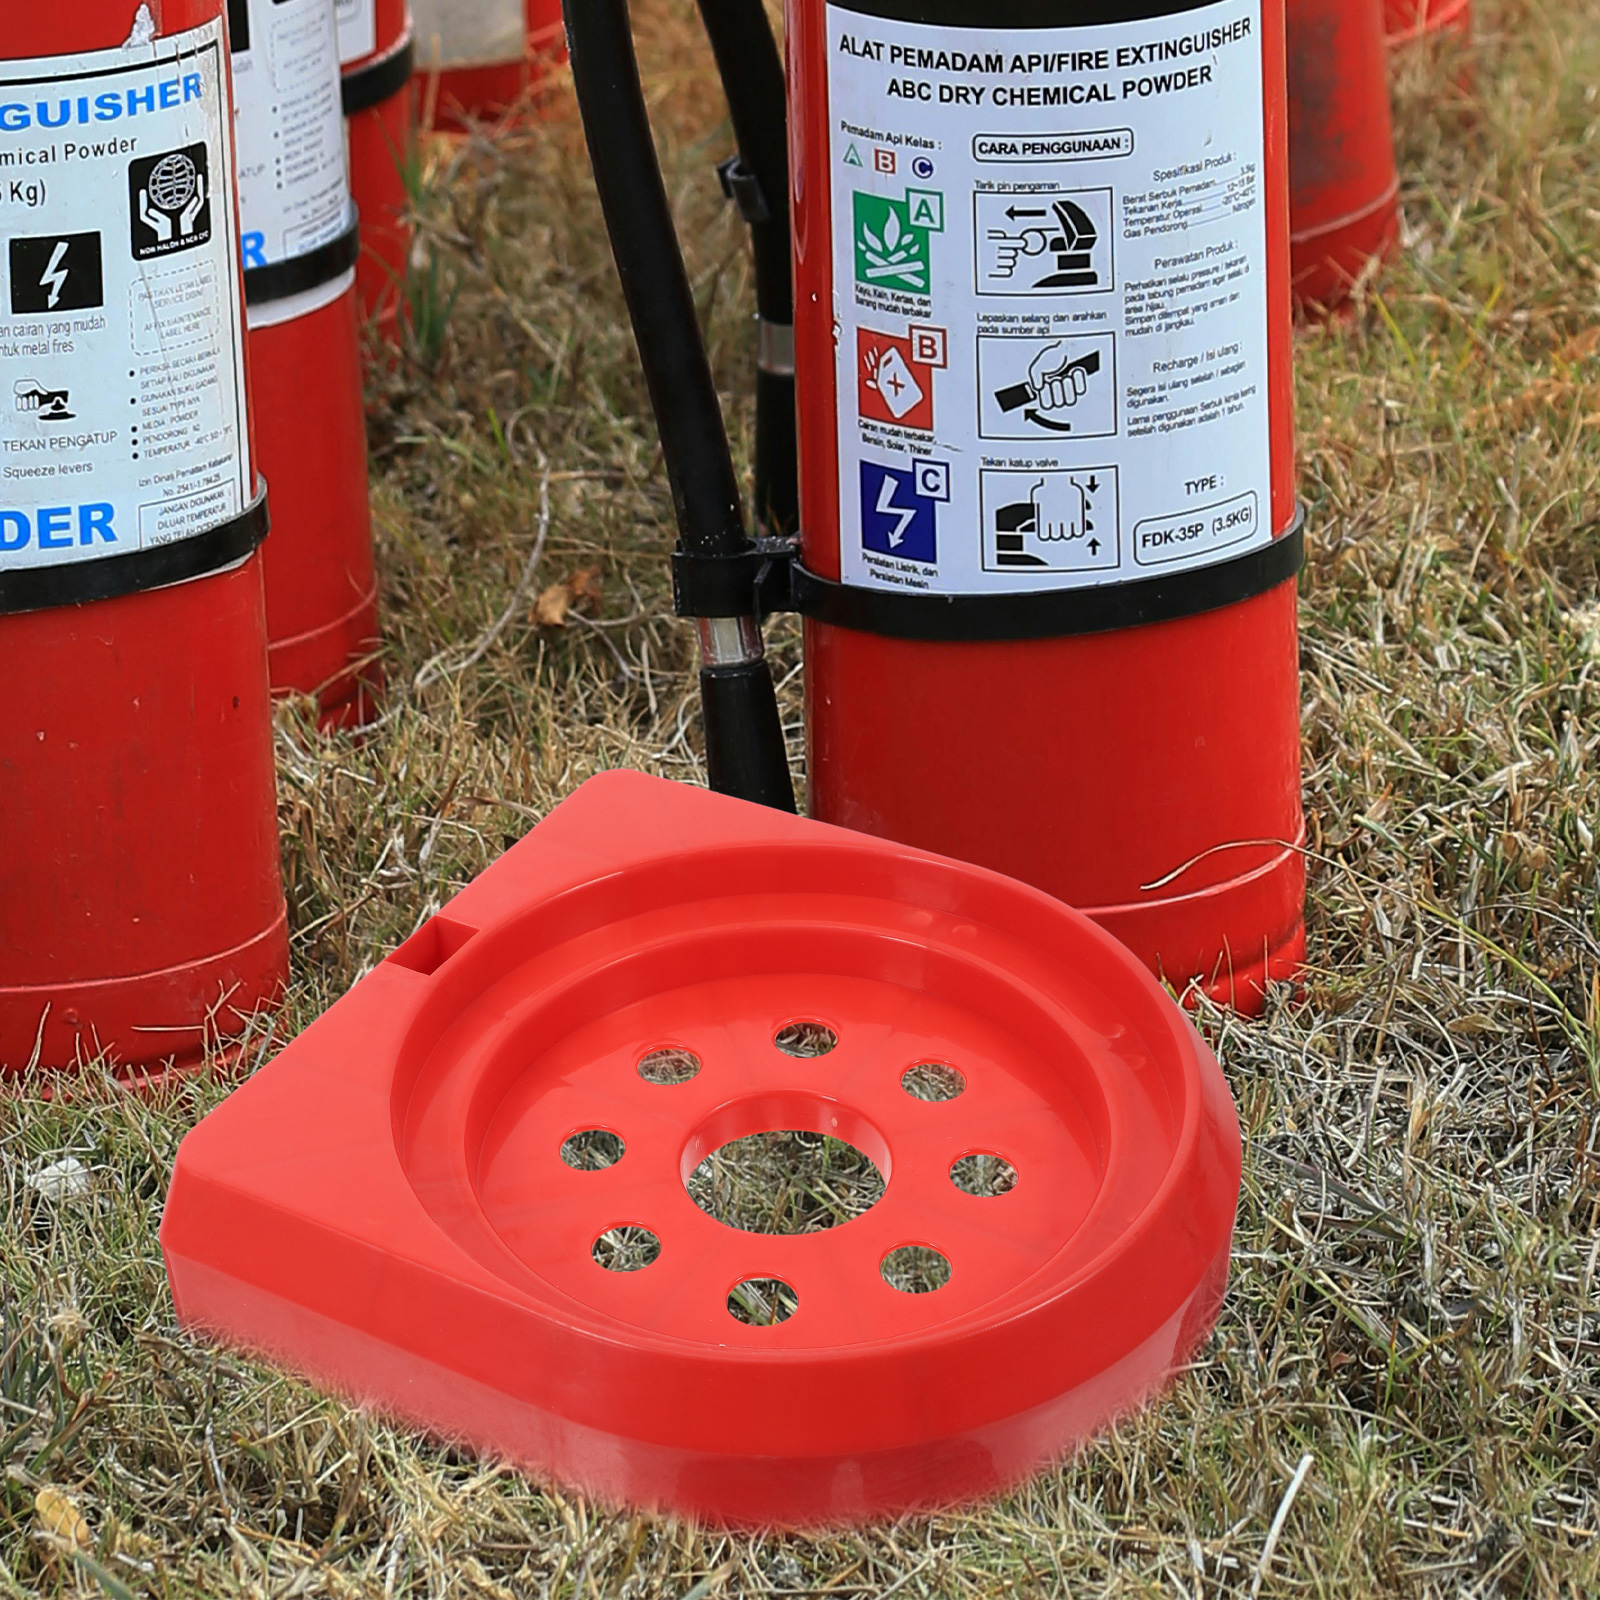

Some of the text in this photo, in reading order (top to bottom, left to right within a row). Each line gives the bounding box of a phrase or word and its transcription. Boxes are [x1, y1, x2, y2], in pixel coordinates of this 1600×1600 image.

[839, 17, 1251, 74] ALAT PEMADAM API/FIRE EXTINGUISHER
[887, 64, 1212, 107] ABC DRY CHEMICAL POWDER
[0, 73, 201, 131] GUISHER
[841, 120, 935, 149] Pemadam Api Kelas
[978, 136, 1121, 155] CARA PENGGUNAAN
[0, 138, 137, 165] mical Powder
[1153, 160, 1203, 182] Spesifikasi
[1204, 152, 1233, 171] Produk
[10, 179, 45, 207] Kg)
[974, 179, 1060, 192] Tarik pin pengaman
[1122, 193, 1147, 205] Berat
[1148, 188, 1177, 201] Serbuk
[913, 198, 936, 224] A
[1122, 199, 1183, 215] Tekanan Kerja
[1123, 213, 1170, 226] Temperatur
[1123, 221, 1188, 239] Gas Pendorong
[1154, 240, 1234, 269] Perawatan Produk
[1124, 278, 1167, 292] Perhatikan
[1190, 265, 1219, 281] pressure
[917, 297, 931, 307] dan
[1125, 294, 1145, 304] pada
[1147, 288, 1174, 301] tabung
[1176, 280, 1210, 296] pemadam
[878, 302, 901, 314] mudah
[976, 311, 1107, 324] Lepaskan selang dan arahkan
[1125, 313, 1156, 325] Simpan
[1191, 303, 1208, 315] yang
[1209, 297, 1228, 308] aman
[13, 322, 43, 337] cairan
[47, 322, 70, 338] yang
[73, 316, 106, 332] mudah
[977, 325, 1050, 335] pada sumber api
[1125, 325, 1153, 337] mudah
[22, 340, 49, 355] metal
[52, 338, 74, 353] fires
[918, 334, 938, 360] B
[1153, 356, 1198, 373] Recharge
[1217, 342, 1239, 358] ulang
[1127, 385, 1156, 397] Segera
[1168, 378, 1188, 391] ulang
[1127, 415, 1150, 426] Lama
[1152, 405, 1198, 423] penggunaan
[1200, 397, 1222, 411] Serbuk
[879, 425, 902, 438] mudah
[1127, 425, 1156, 437] setelah
[1158, 418, 1196, 432] digunakan
[3, 431, 117, 452] TEKAN PENGATUP
[144, 440, 190, 458] TEMPERATUR
[3, 461, 93, 480] Squeeze levers
[981, 456, 1059, 468] Tekan katup valve
[153, 474, 174, 484] Dinas
[921, 468, 941, 493] C
[1185, 475, 1217, 495] TYPE
[159, 490, 224, 516] JANGAN DIGUNAKAN
[0, 502, 118, 551] DER
[158, 516, 185, 530] DILUAR
[186, 502, 226, 521] TEMPERATUR
[1142, 505, 1252, 549] FDK-35P (3.5KG)
[862, 552, 895, 570] Peralatan
[922, 567, 938, 577] dan
[870, 568, 929, 590] Peralatan Mesin
